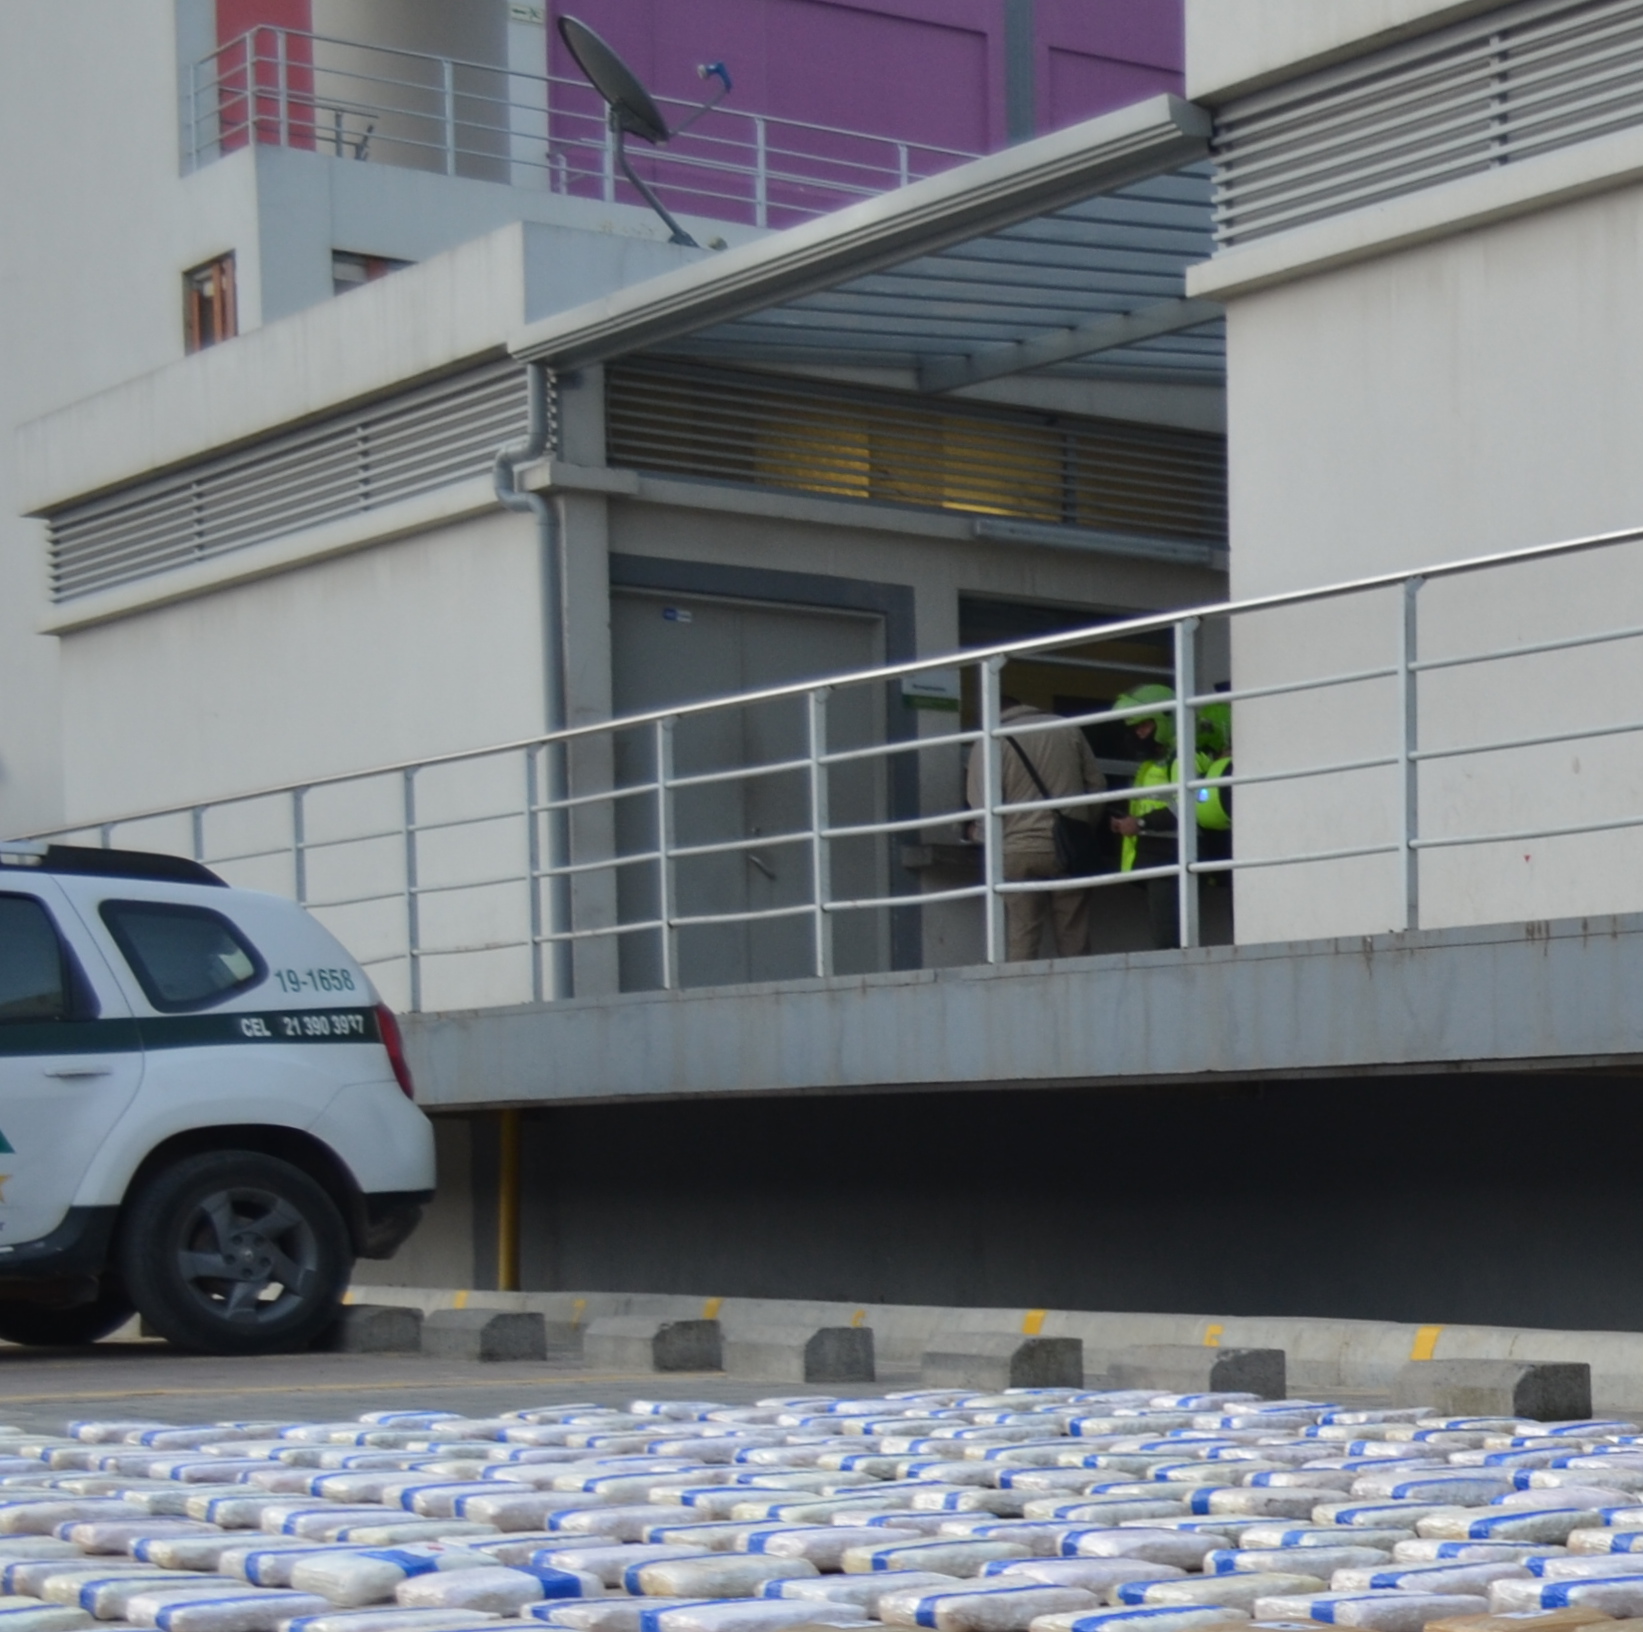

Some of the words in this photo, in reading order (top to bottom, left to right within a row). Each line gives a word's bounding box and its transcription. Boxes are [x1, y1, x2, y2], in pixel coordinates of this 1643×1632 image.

[274, 968, 355, 993] 19-1658
[240, 1017, 272, 1037] CEL
[282, 1016, 302, 1036] 21
[302, 1015, 330, 1036] 390
